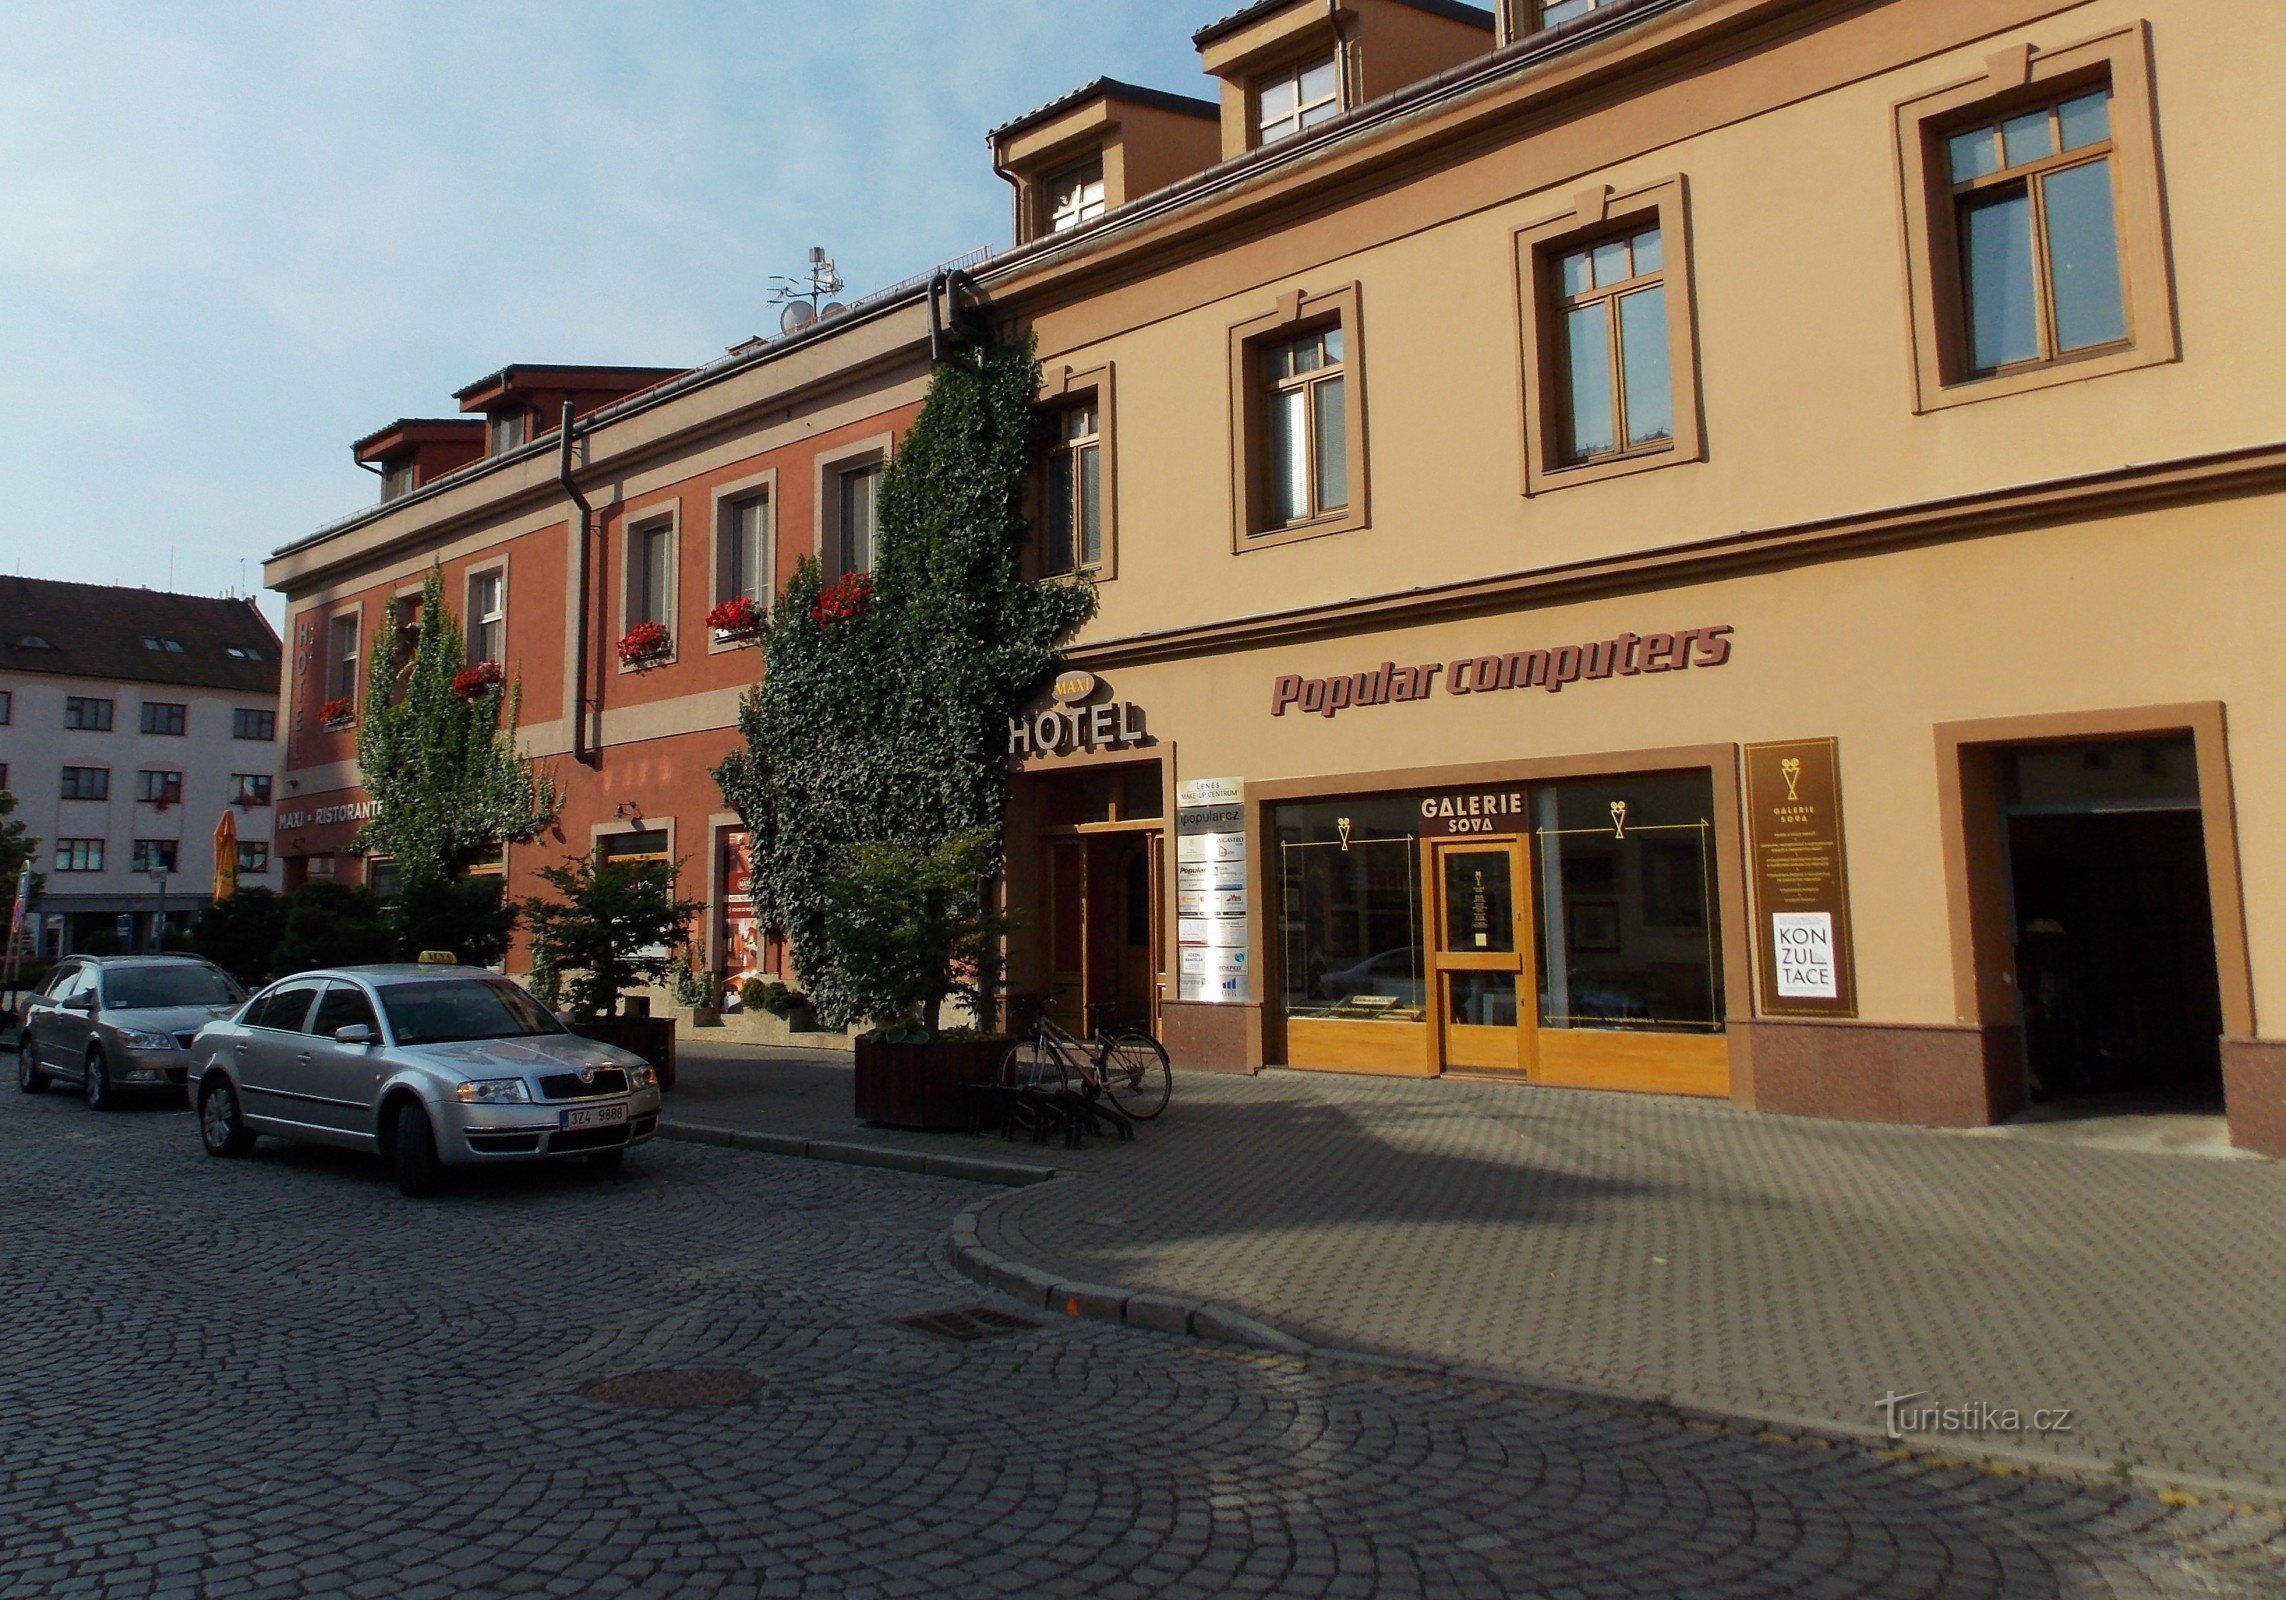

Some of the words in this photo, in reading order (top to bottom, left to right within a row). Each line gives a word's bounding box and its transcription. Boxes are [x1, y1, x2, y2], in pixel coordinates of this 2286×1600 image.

[1271, 660, 1443, 718] Popular
[1445, 624, 1735, 693] computers
[295, 623, 309, 760] HOTEL
[1055, 677, 1090, 696] MAXI
[1009, 701, 1142, 754] HOTEL
[1208, 790, 1238, 798] CENTRUM
[1421, 793, 1522, 818] GALERIE
[1773, 805, 1815, 815] GALERIE
[279, 811, 304, 829] MAXI
[315, 800, 383, 825] RISTORANTE
[1781, 815, 1808, 823] SOVA
[1448, 818, 1494, 833] SOVA
[1780, 928, 1827, 945] KON
[1782, 948, 1828, 965] ZUL
[1783, 968, 1829, 985] TACE
[571, 1111, 591, 1125] 3Z4
[599, 1107, 623, 1122] 9888
